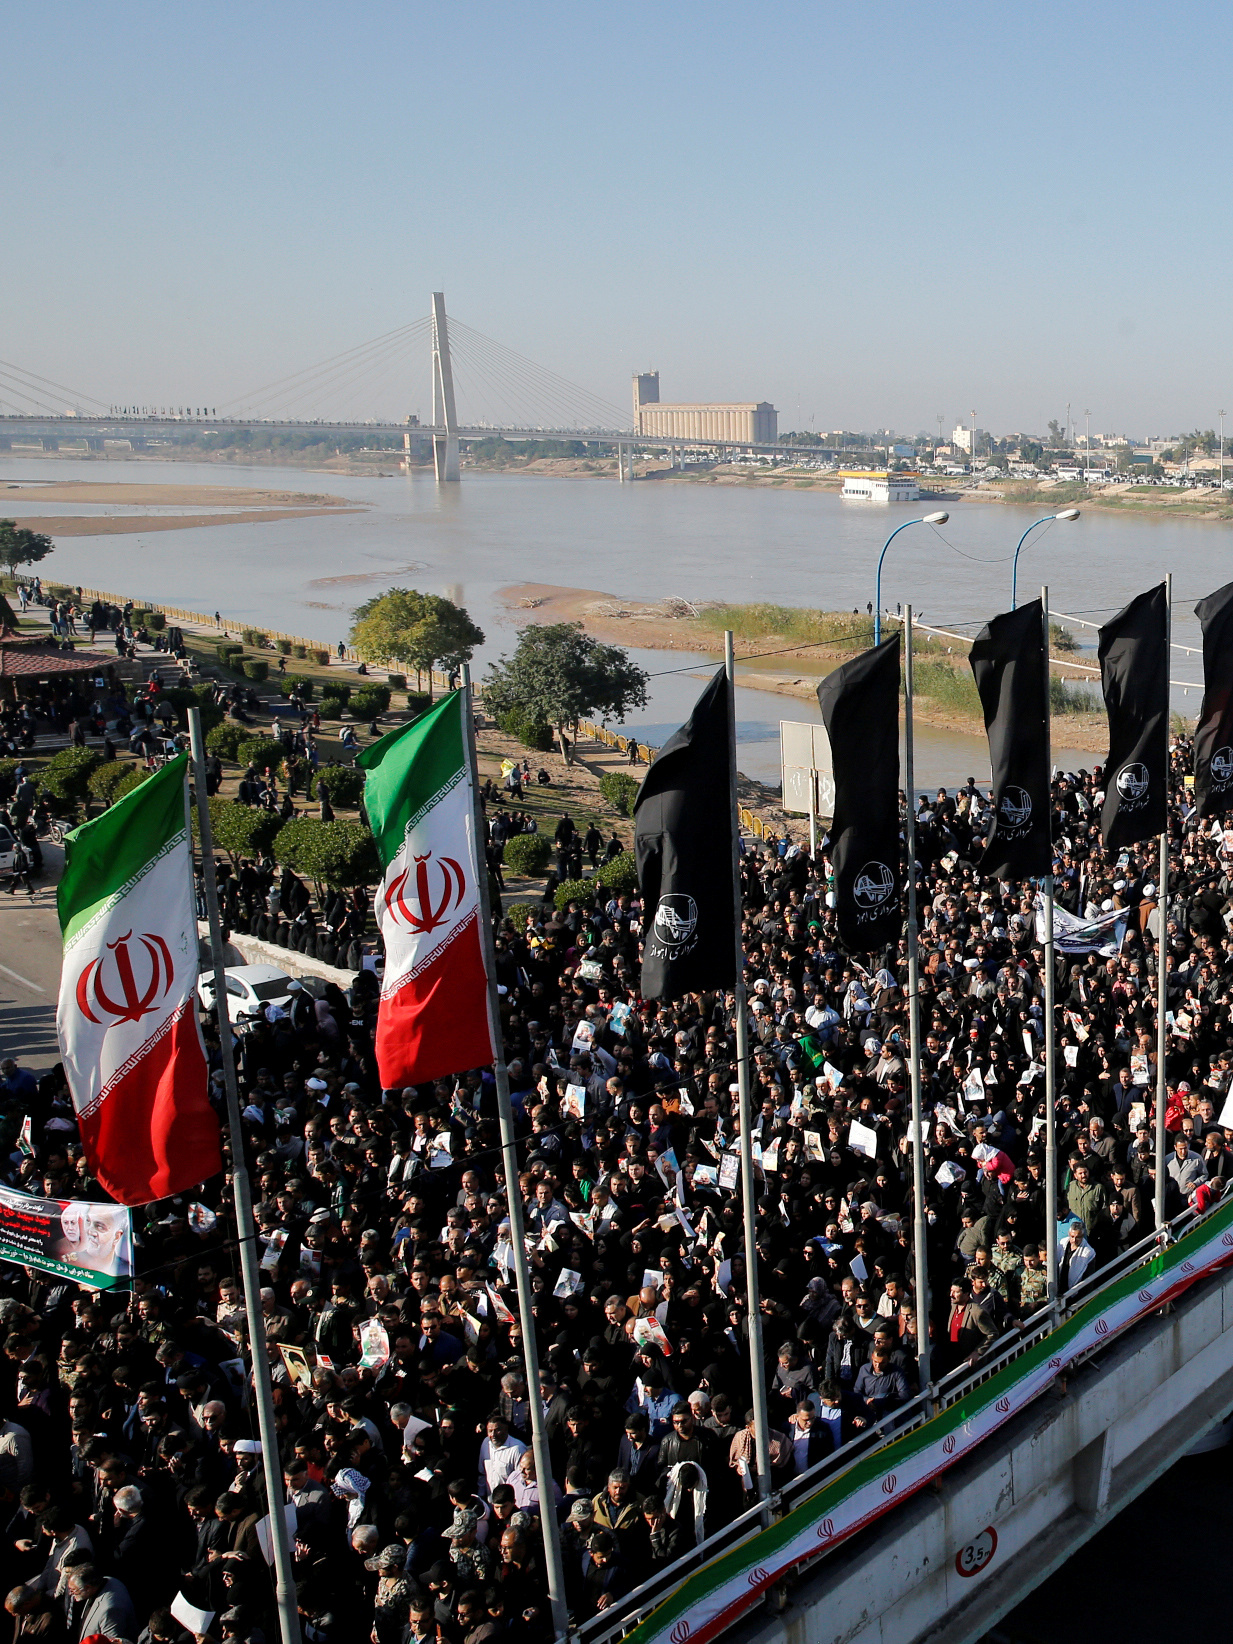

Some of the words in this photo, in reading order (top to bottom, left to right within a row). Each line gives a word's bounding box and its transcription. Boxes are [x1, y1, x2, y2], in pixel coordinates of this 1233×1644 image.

[870, 898, 899, 921] شهرداری
[650, 944, 667, 960] اهواز
[669, 934, 699, 961] شهرداری
